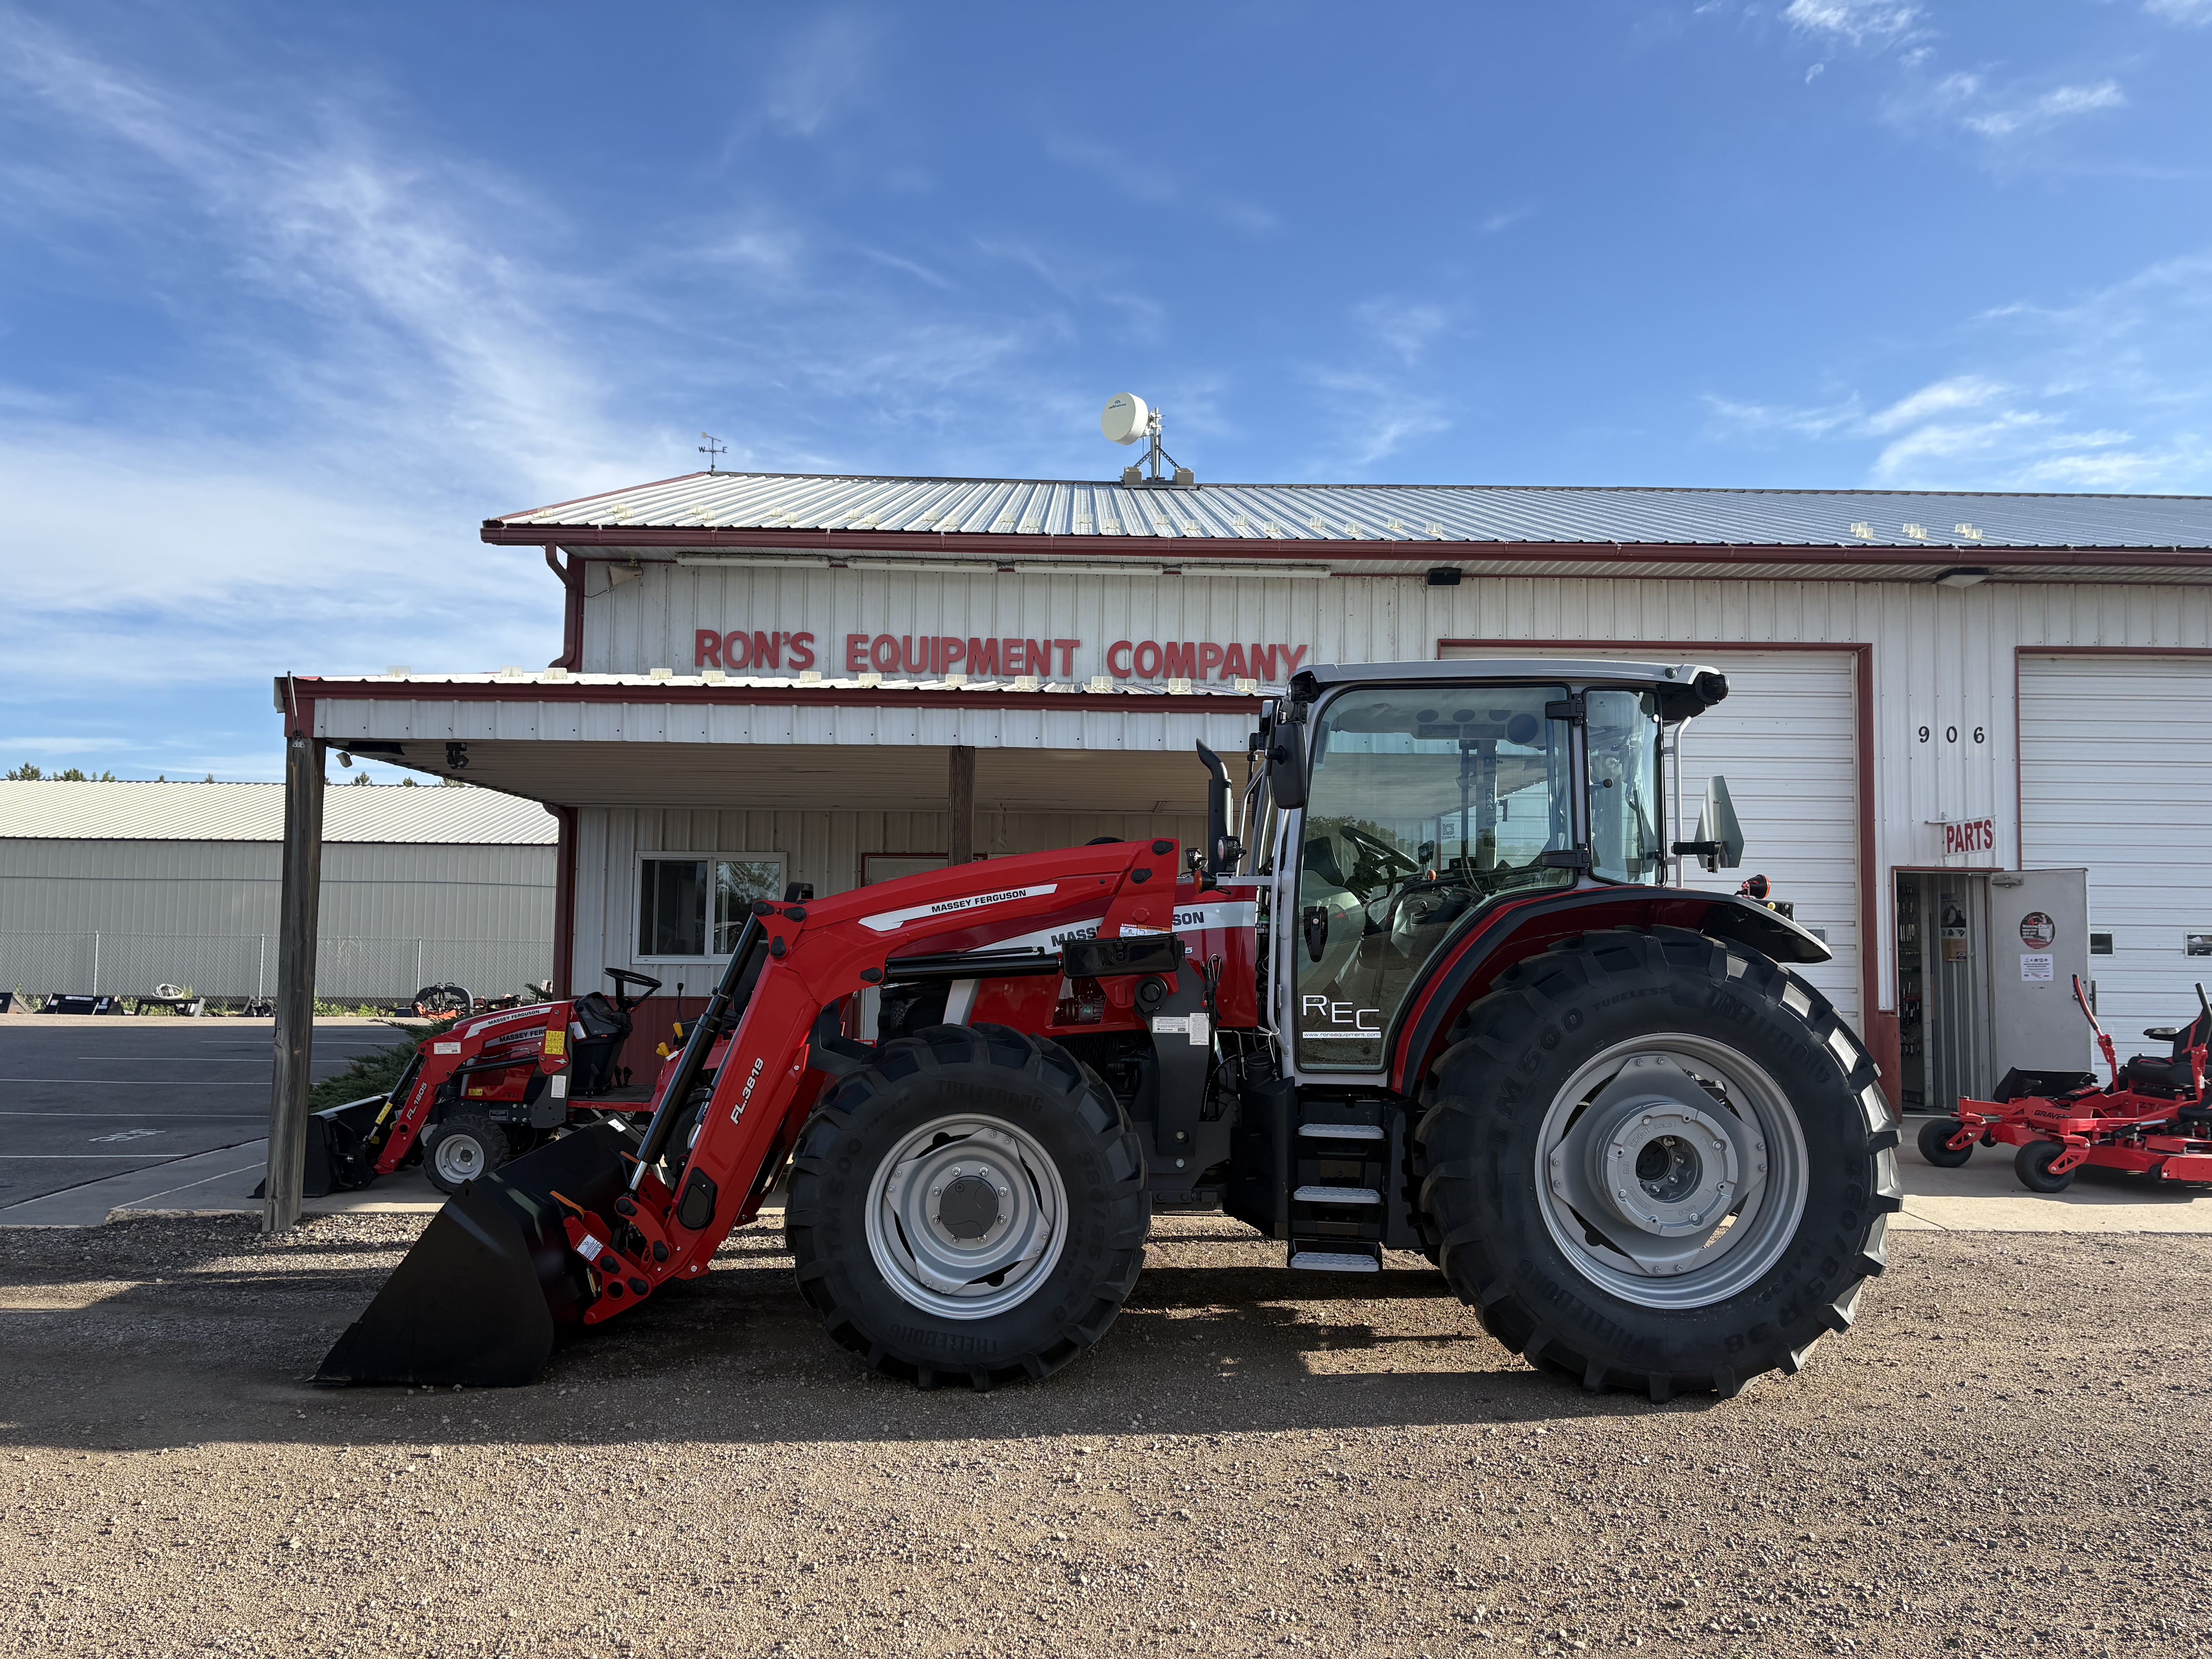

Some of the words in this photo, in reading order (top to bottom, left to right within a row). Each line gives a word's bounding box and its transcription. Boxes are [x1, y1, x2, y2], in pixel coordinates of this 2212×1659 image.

[695, 629, 815, 670] RON'S
[846, 634, 1080, 676] EQUIPMENT
[1106, 639, 1308, 680] COMPANY
[1946, 819, 1994, 854] PARTS
[931, 899, 971, 914] MASSEY
[974, 888, 1027, 907] FERGUSON
[1051, 926, 1101, 947] MASS
[1303, 995, 1380, 1030] REC
[1592, 986, 1669, 1011] TUBELESS
[488, 1015, 510, 1025] MASSEY
[511, 1009, 540, 1019] FERGUSON
[1705, 982, 1835, 1085] TRELLEBORG
[499, 1032, 528, 1042] MASSEY
[730, 1057, 764, 1126] FL.3819
[936, 1080, 1045, 1113] TRELLEBORG
[1511, 1258, 1645, 1359] TRELLEBORG
[886, 1321, 1000, 1356] TRELLEBORG
